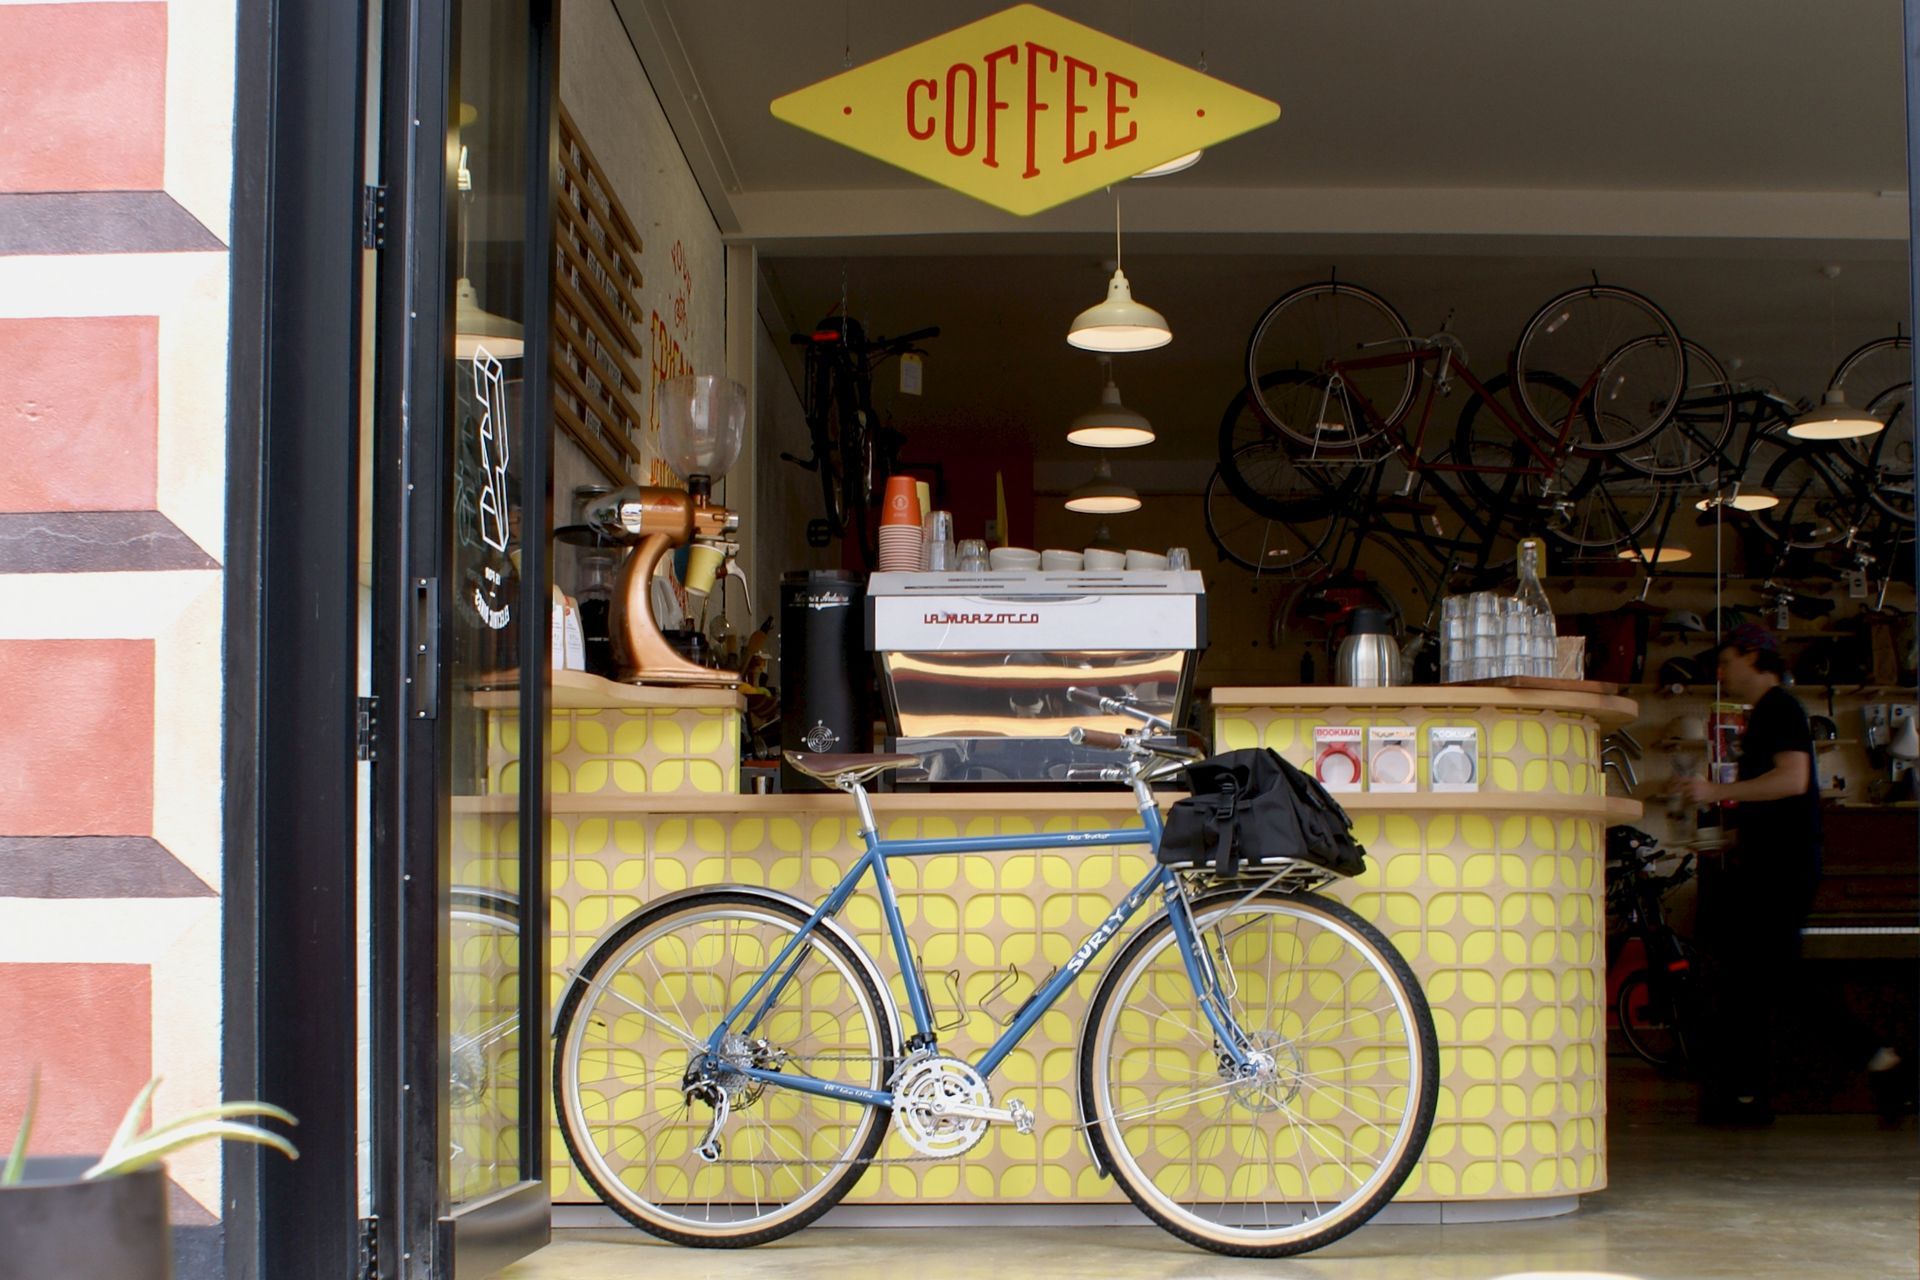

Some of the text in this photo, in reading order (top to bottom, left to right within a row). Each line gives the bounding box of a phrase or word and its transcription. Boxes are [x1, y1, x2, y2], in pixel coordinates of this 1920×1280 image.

[907, 42, 1138, 179] COFFEE
[924, 613, 938, 624] LA
[1317, 729, 1360, 737] BOOKMAN
[1067, 908, 1125, 974] SURLY
